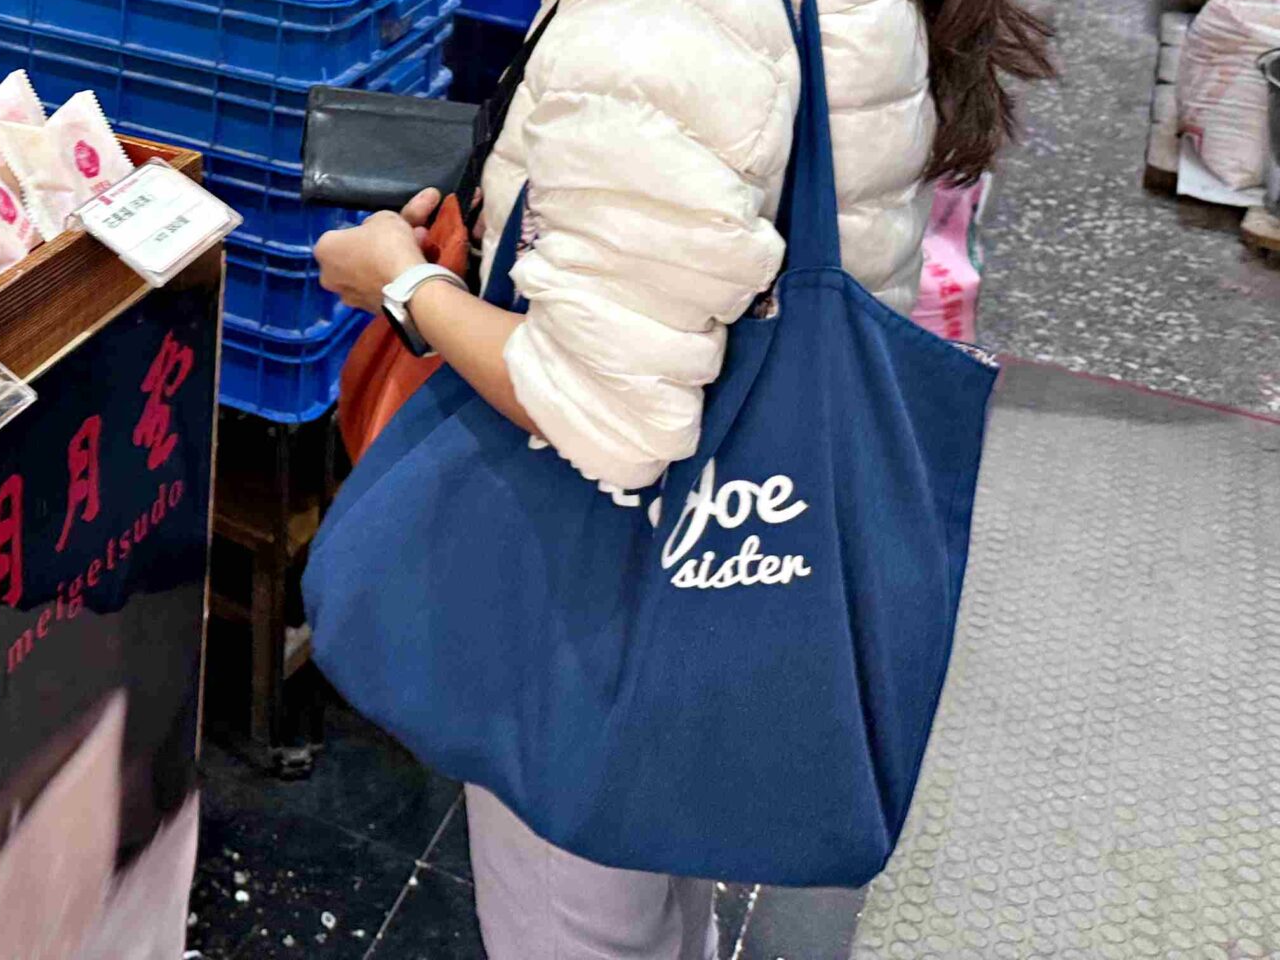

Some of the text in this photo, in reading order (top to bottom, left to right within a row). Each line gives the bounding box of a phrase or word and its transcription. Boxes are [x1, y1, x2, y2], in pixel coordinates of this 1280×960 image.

[662, 456, 809, 570] Joe
[670, 534, 812, 589] sister
[8, 478, 184, 674] meigetsudo
